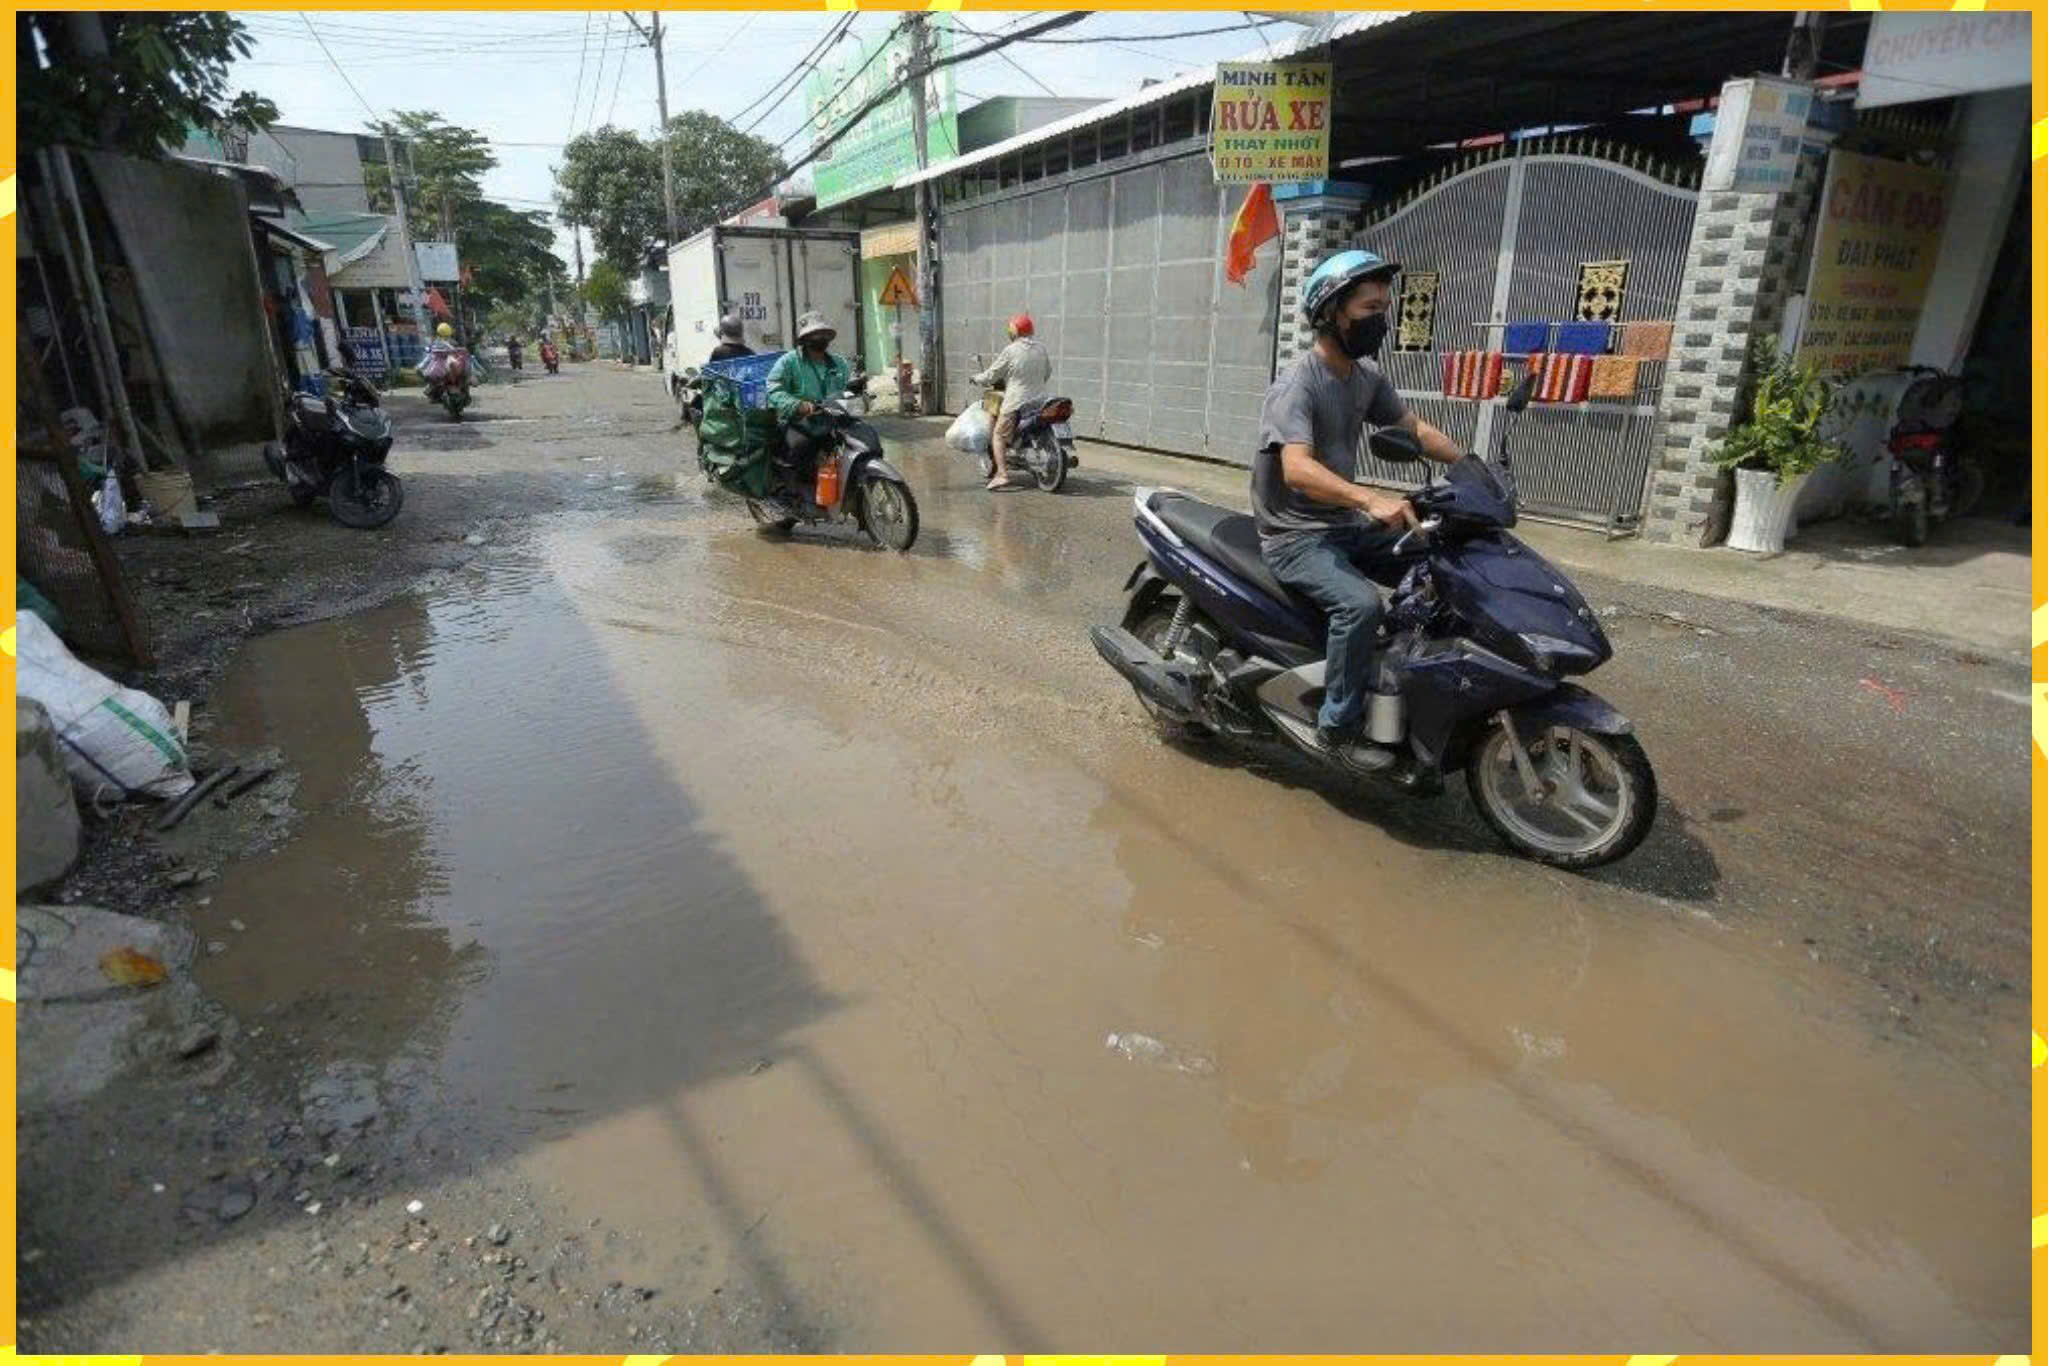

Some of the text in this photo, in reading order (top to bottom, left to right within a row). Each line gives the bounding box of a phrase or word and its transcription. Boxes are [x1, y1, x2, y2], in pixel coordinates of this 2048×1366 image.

[1223, 68, 1326, 86] MINH TÂN
[1219, 89, 1324, 131] RỬA XE
[1224, 139, 1267, 150] THAY
[1269, 156, 1287, 168] XE
